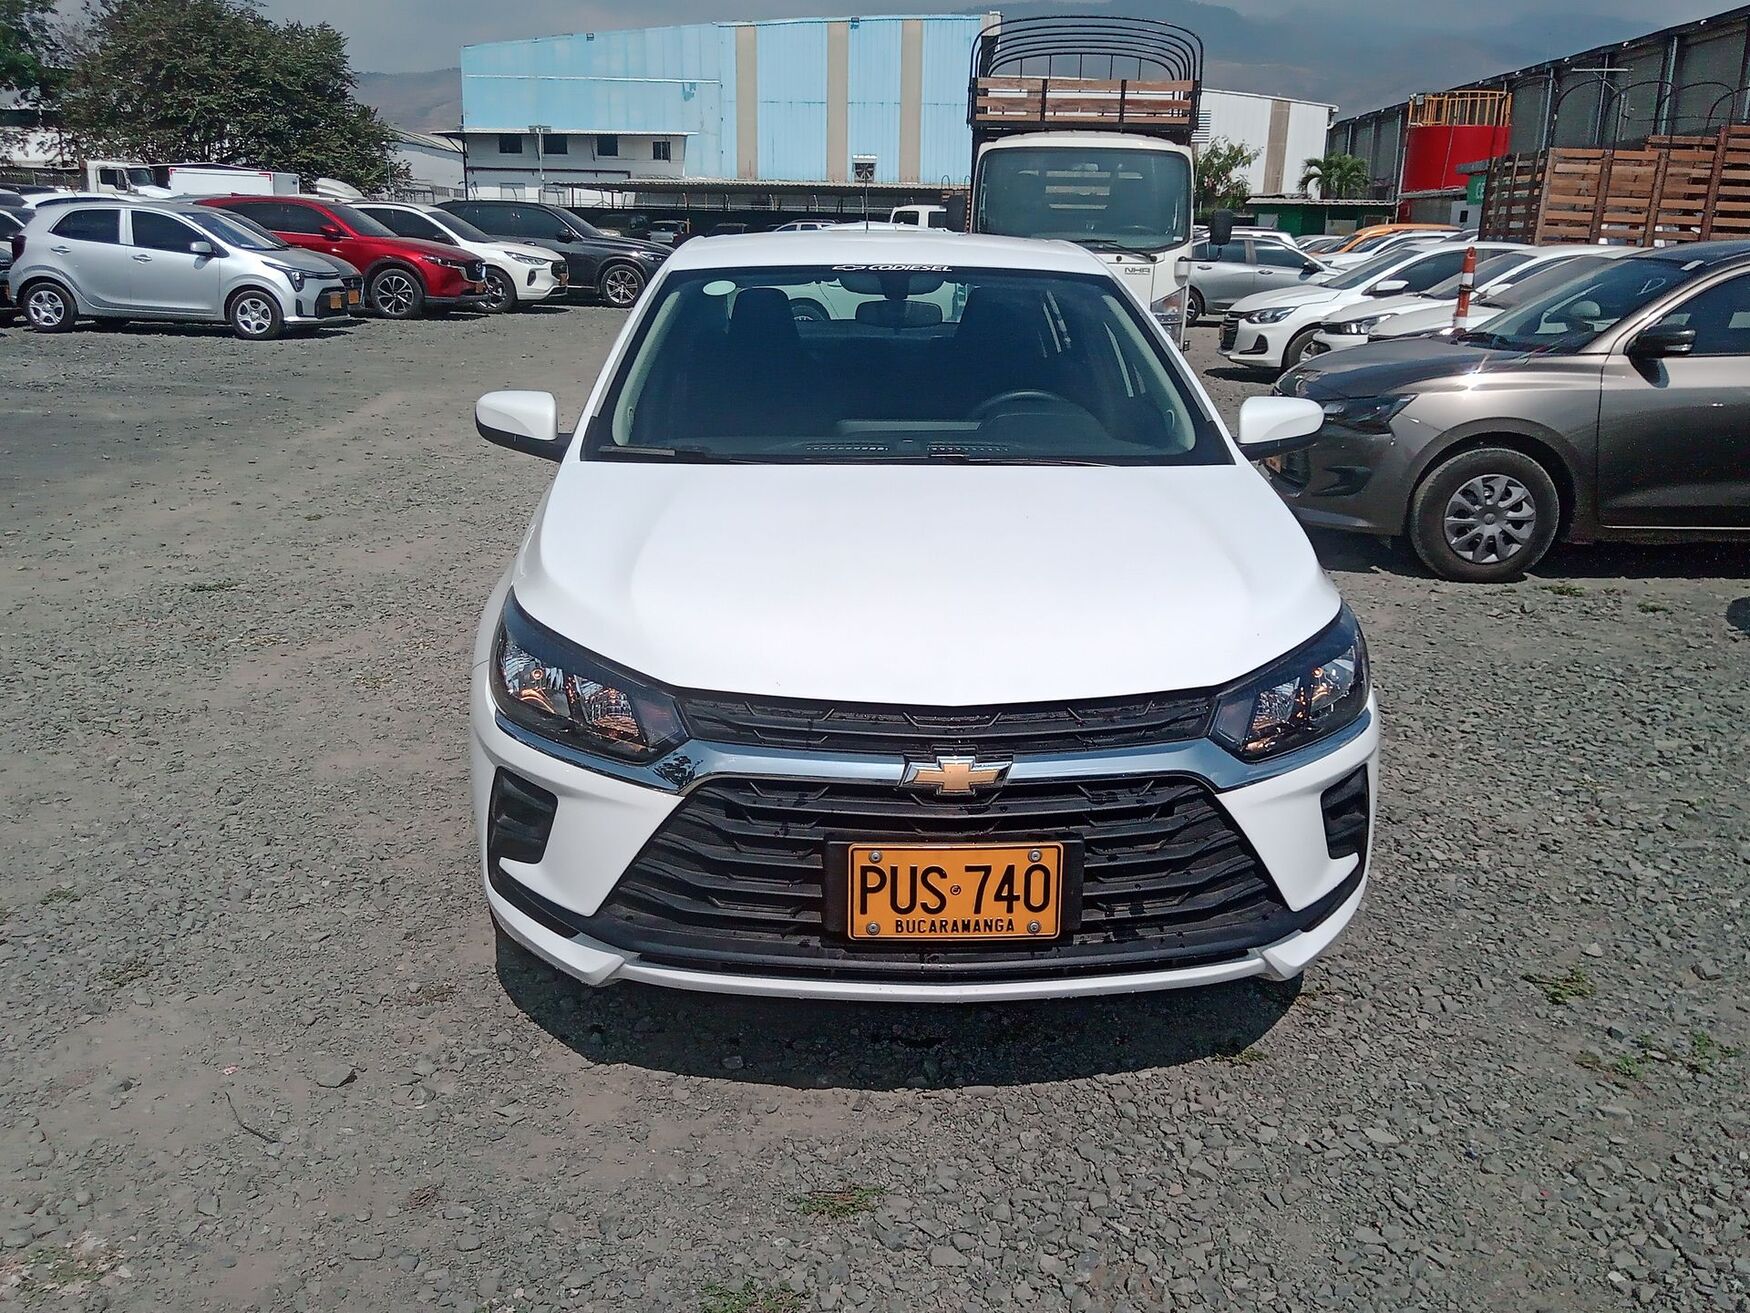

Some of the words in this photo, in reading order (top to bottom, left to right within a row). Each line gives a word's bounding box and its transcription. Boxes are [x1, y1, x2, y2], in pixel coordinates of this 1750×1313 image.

[868, 263, 953, 273] CODIESEL
[860, 865, 948, 915] PUS
[965, 864, 1050, 914] 740
[895, 917, 1014, 934] BUCARAMANGA
